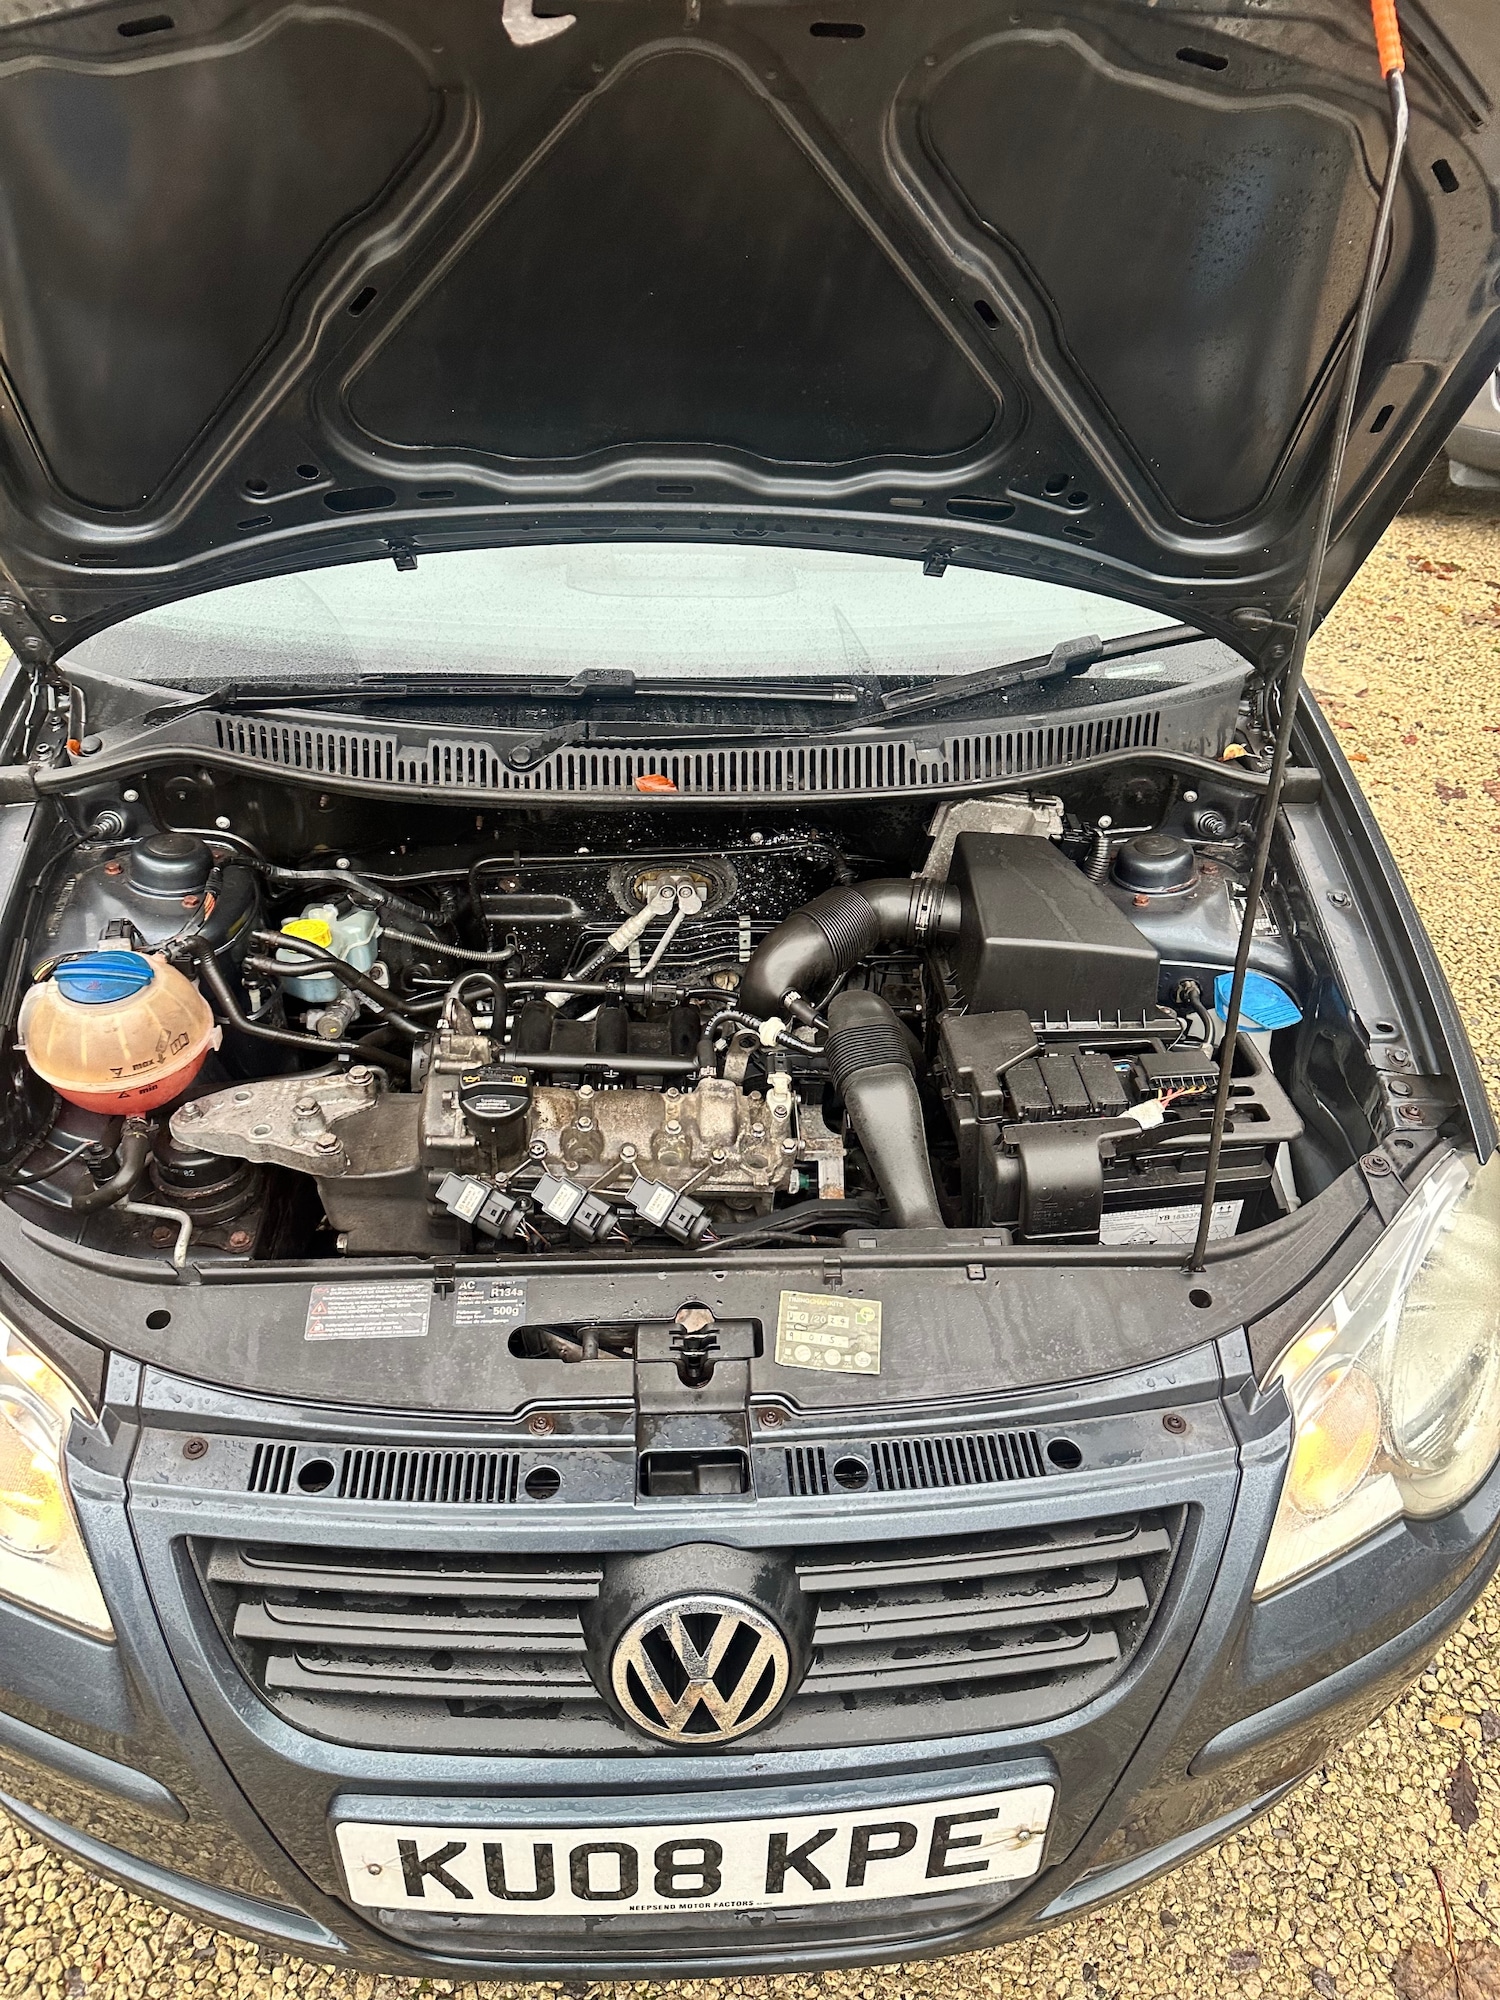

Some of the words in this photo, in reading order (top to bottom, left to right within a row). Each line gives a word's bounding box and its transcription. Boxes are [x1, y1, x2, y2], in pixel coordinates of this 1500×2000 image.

[132, 1059, 155, 1071] max
[139, 1084, 158, 1095] min
[458, 1280, 476, 1290] AC
[490, 1287, 524, 1297] R134a
[493, 1306, 520, 1317] 500g
[765, 1807, 1001, 1894] KPE
[397, 1838, 724, 1901] KU08
[629, 1903, 676, 1911] NEEPSEND
[678, 1902, 711, 1910] MOTOR
[713, 1900, 754, 1908] FACTORS
